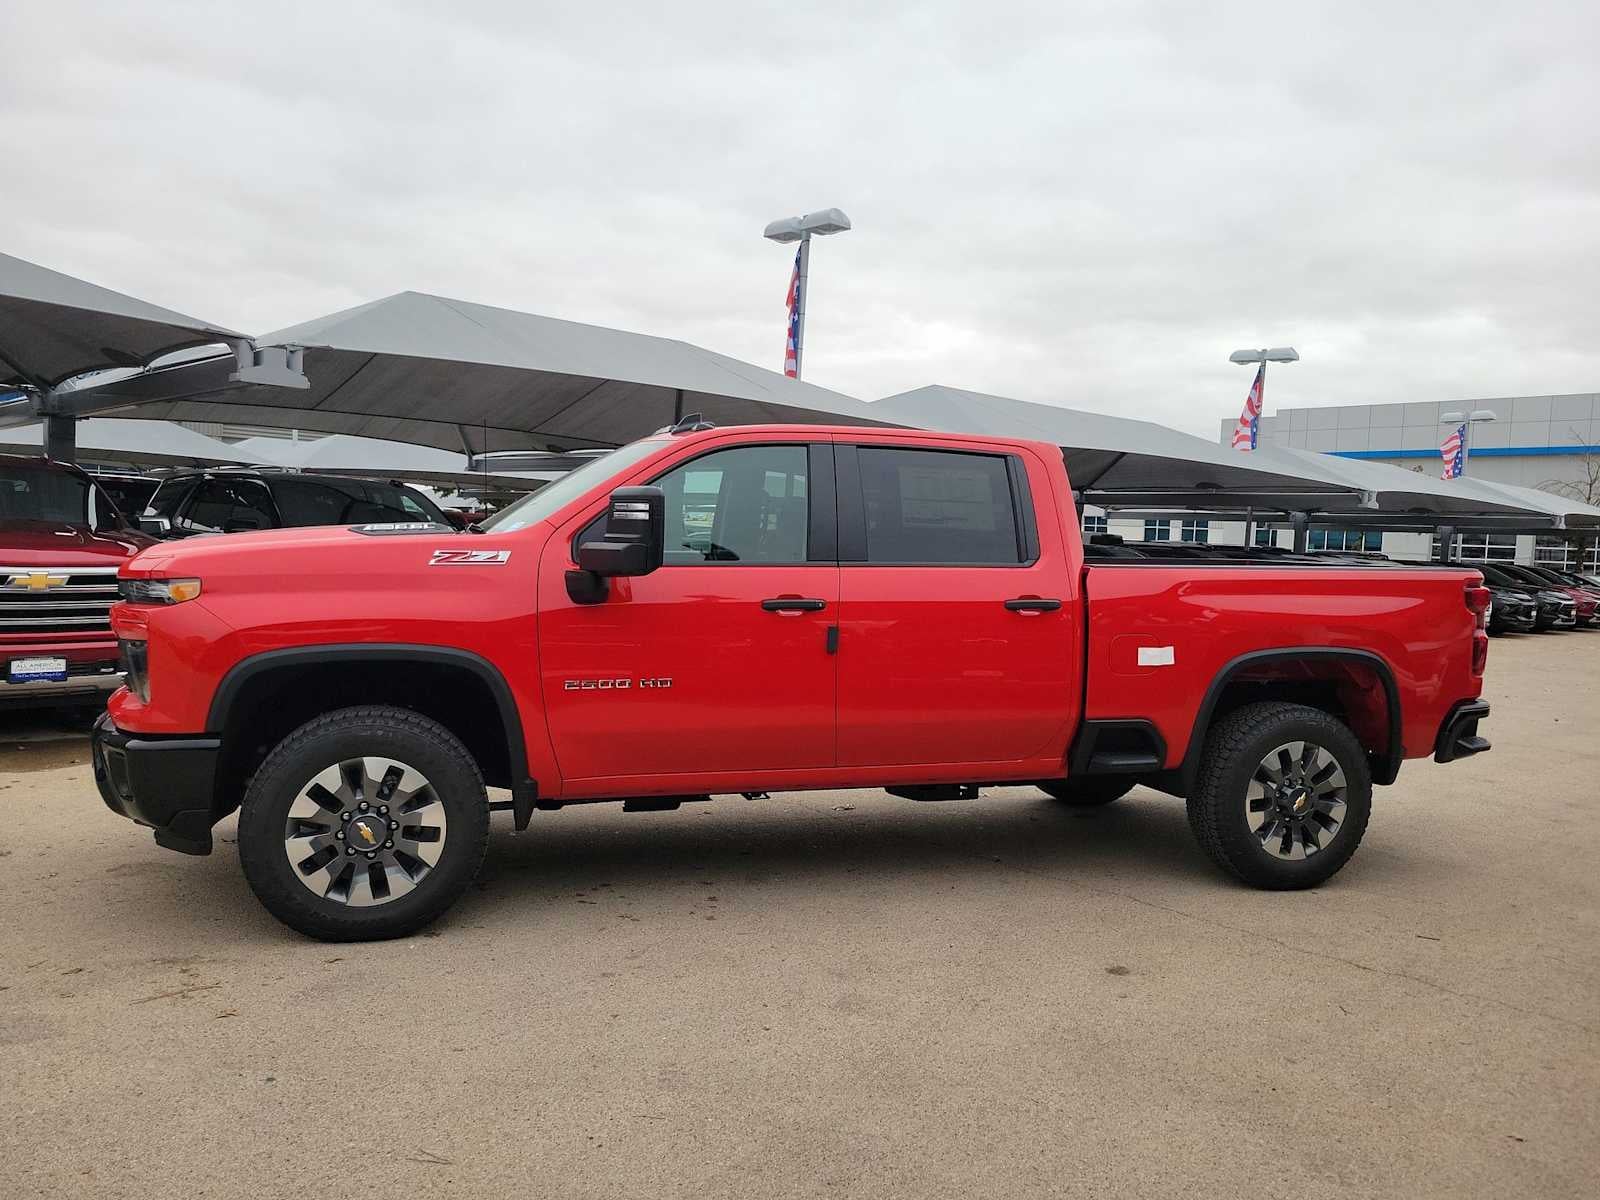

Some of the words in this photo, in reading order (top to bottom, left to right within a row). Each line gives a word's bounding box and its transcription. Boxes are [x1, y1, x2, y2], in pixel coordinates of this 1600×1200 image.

[428, 550, 512, 566] Z71
[564, 679, 631, 690] 2500
[639, 678, 672, 688] HD
